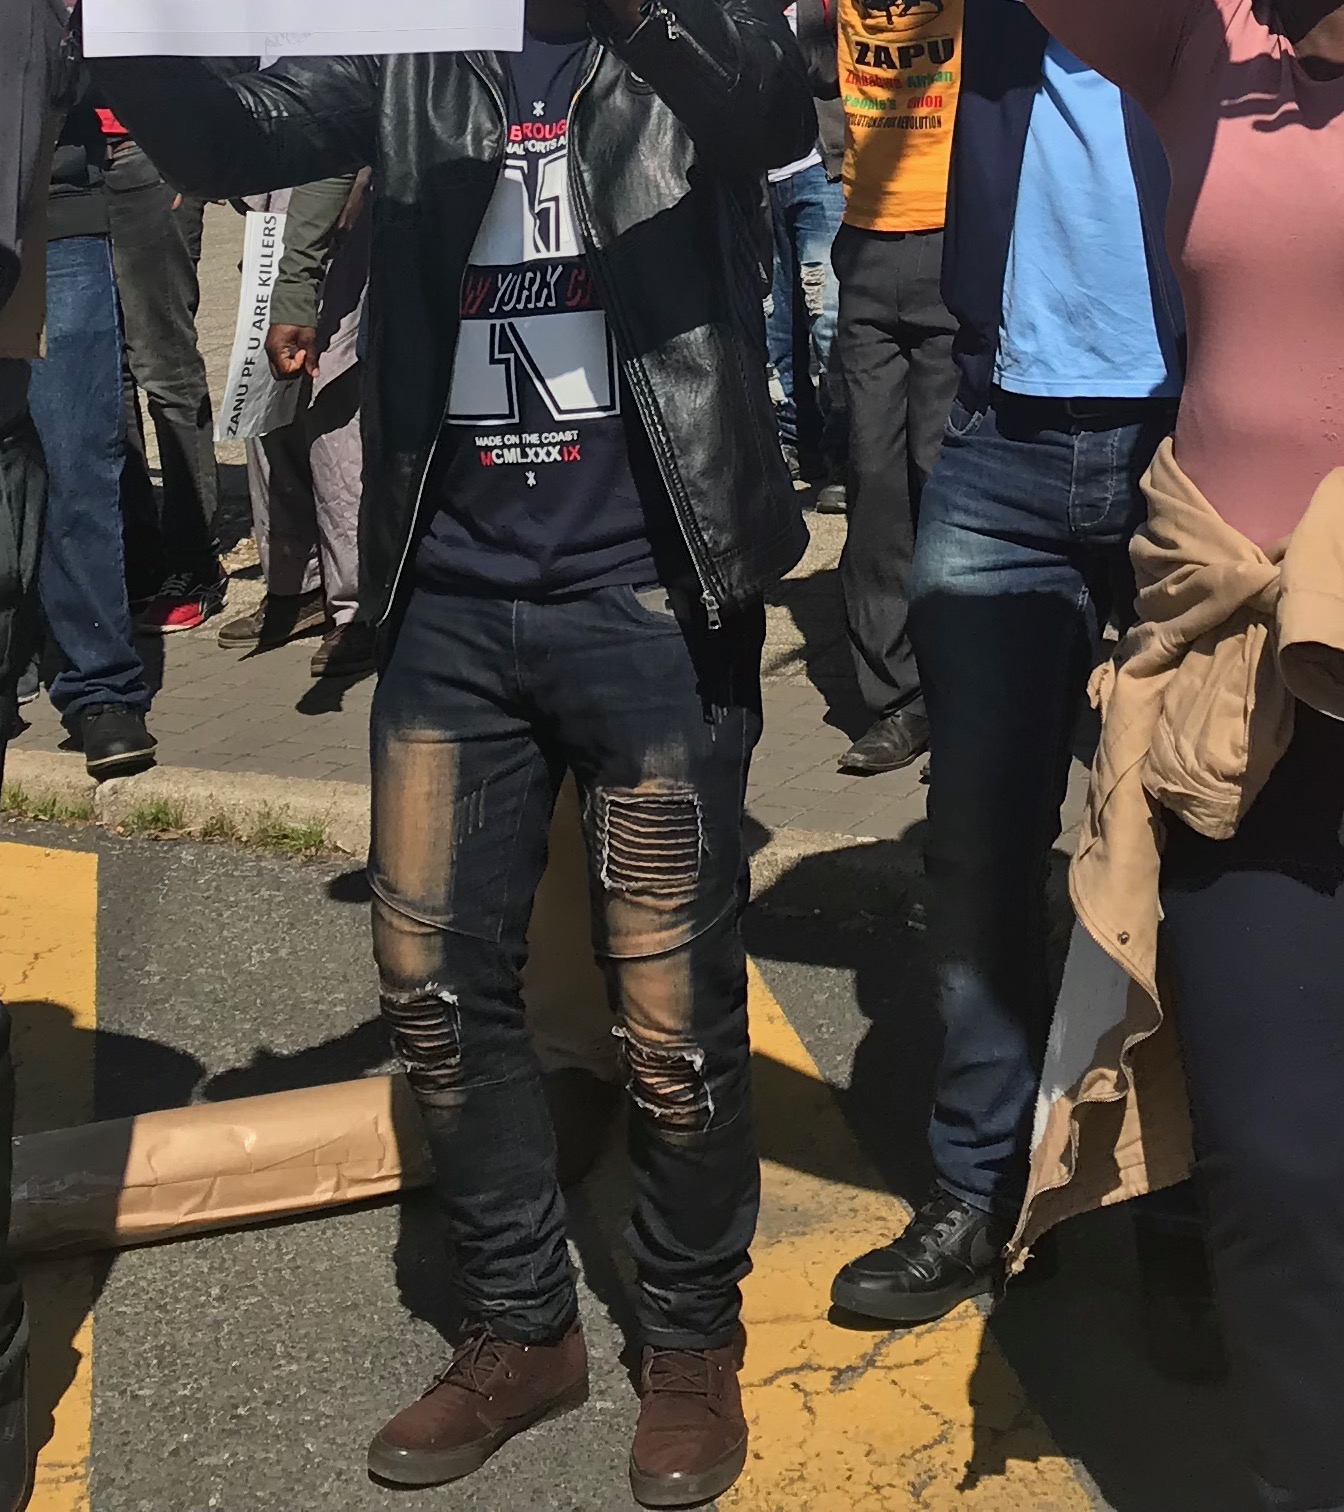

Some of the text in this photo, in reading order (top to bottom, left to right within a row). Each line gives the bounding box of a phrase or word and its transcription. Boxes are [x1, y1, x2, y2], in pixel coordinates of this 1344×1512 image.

[855, 38, 955, 69] ZAPU
[227, 215, 277, 436] ZANU PF U ARE KILLERS
[475, 430, 578, 446] MADE ON THE COAST
